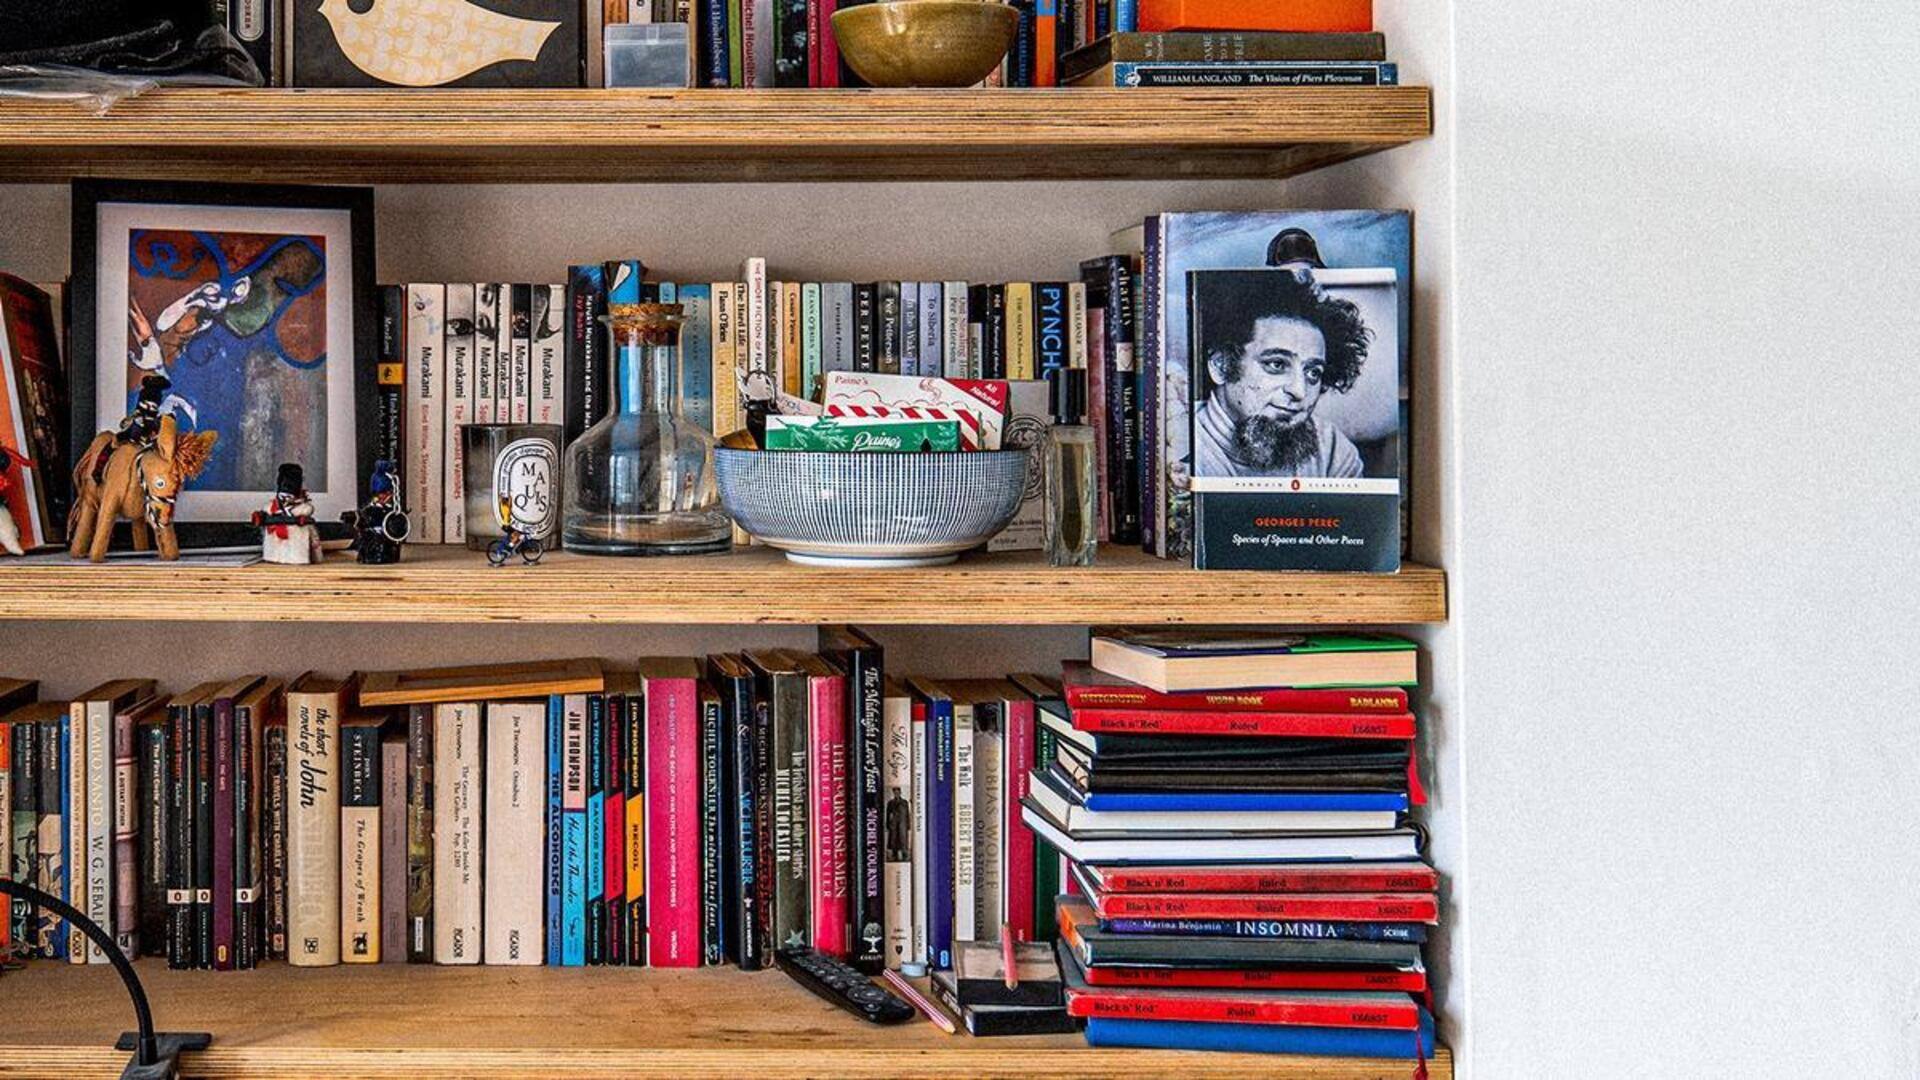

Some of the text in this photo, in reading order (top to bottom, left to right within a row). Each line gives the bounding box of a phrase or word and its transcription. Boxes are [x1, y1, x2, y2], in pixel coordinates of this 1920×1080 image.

[1152, 75, 1191, 84] WILLIAM
[1192, 75, 1242, 84] LANGLAND
[1248, 74, 1263, 84] The
[738, 284, 746, 301] The
[754, 277, 762, 304] SHORT
[860, 291, 870, 317] PER
[738, 304, 746, 327] Hard
[738, 330, 746, 346] Life
[754, 306, 762, 339] FICTION
[885, 298, 894, 364] Per Petterson
[906, 312, 914, 328] the
[928, 296, 937, 346] To Siberia
[950, 297, 958, 363] Per Petterson
[754, 340, 761, 351] OF
[906, 331, 914, 358] Wake
[421, 346, 432, 398] Murakami
[455, 346, 466, 398] Murakami
[480, 346, 492, 398] Murakami
[500, 352, 509, 399] Murakami
[516, 345, 526, 397] Murakami
[542, 348, 554, 399] Murakami
[584, 395, 592, 410] the
[1124, 386, 1134, 460] Mark Richard
[1232, 534, 1364, 546] Species of Spaces and Other Pieces
[1254, 518, 1341, 528] GEORGES PEREC
[1350, 697, 1399, 708] BADLANDS
[294, 706, 312, 756] novels of
[316, 708, 330, 756] the short
[569, 712, 580, 792] JIM THOMPSON
[737, 724, 748, 738] &
[758, 728, 767, 768] MICHEL
[861, 668, 880, 794] The Midnight Love Feast
[888, 724, 908, 778] The Ogre
[353, 734, 362, 801] STEINBECK
[834, 744, 846, 775] THE
[958, 745, 971, 788] The Walk
[92, 714, 104, 873] CAMPO SANTO W. G.
[300, 760, 327, 808] John
[512, 770, 520, 802] Omnibus
[670, 784, 676, 794] OF
[707, 707, 717, 878] MICHEL TOURNIER midnight
[759, 772, 768, 828] TOURNIER
[776, 768, 790, 808] MICHEL
[272, 775, 282, 868] TRAVELS WITH CHARLEY
[552, 771, 560, 896] THE ALCOHOLICS
[592, 802, 600, 849] SAVAGE
[792, 752, 806, 878] The and other stories
[822, 741, 832, 898] MICHEL TOURNIER
[834, 818, 846, 859] WISE
[462, 852, 470, 872] Inside
[568, 816, 580, 904] Heed the Thunder
[866, 808, 878, 897] MICHEL TOURNIER
[959, 803, 971, 886] ROBERT WALSER
[976, 820, 985, 892] OUR STORY
[986, 825, 999, 890] WOLFF
[354, 819, 366, 922] The Grapes of Wrath
[592, 852, 600, 892] NIGHT
[834, 861, 846, 898] MEN
[73, 930, 82, 958] PICADOR
[454, 928, 462, 958] PICADOR
[510, 930, 519, 960] PICADOR
[670, 930, 678, 959] VINTAGE
[1142, 920, 1338, 937] Marina Benjamin INSOMNIA
